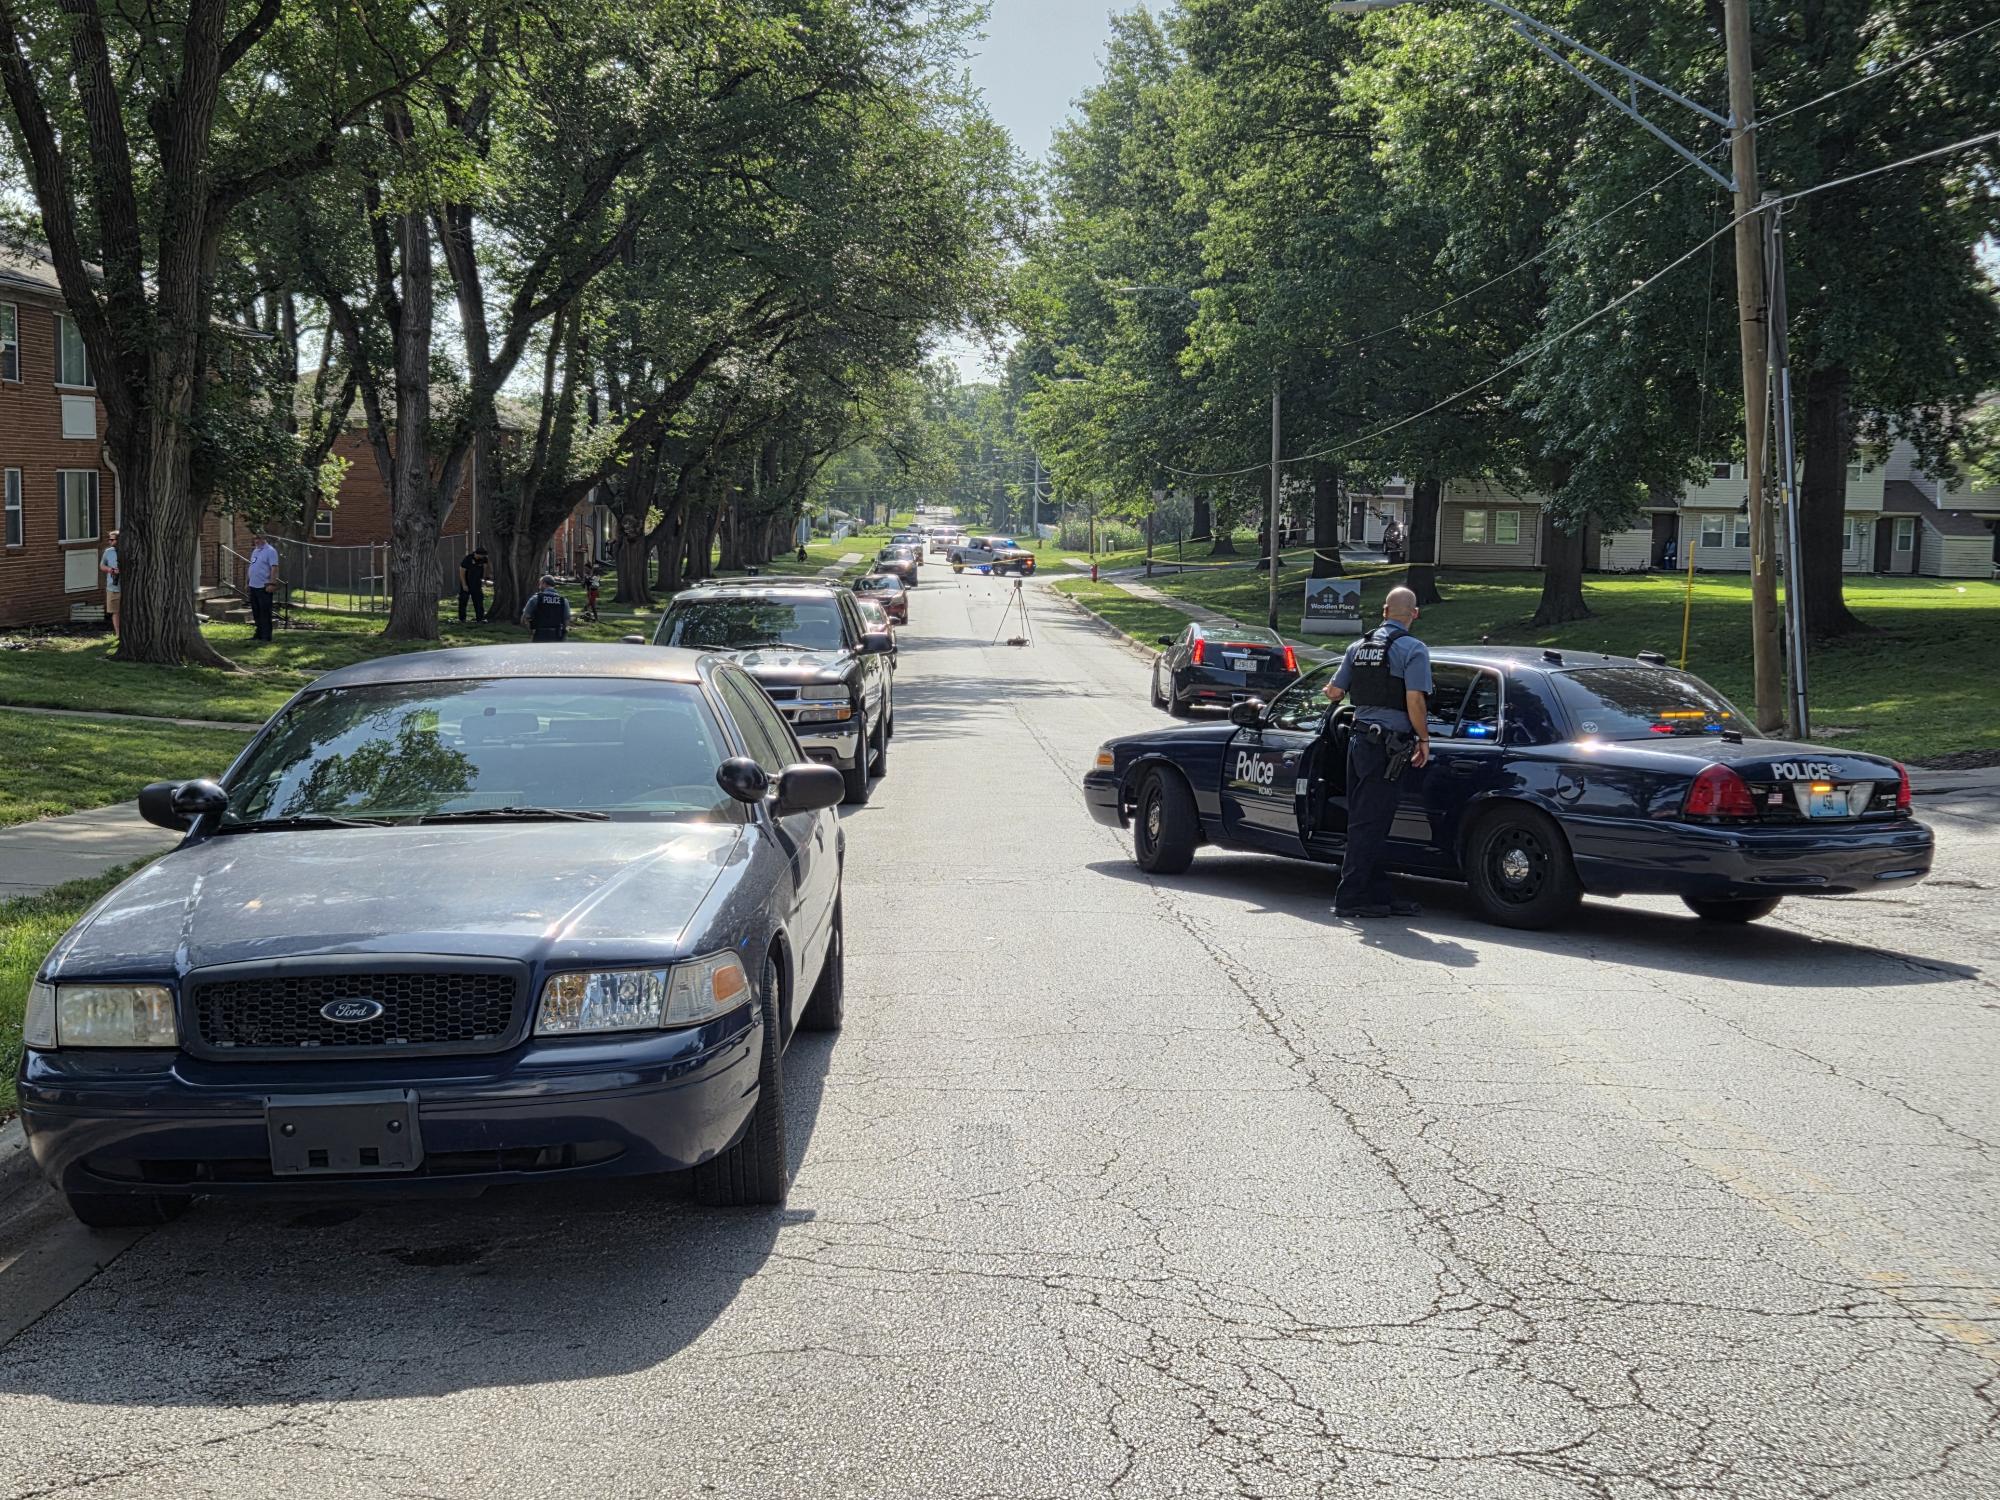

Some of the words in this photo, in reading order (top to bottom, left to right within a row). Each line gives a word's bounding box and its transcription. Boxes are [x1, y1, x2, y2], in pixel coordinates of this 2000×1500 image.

[543, 596, 560, 604] POLICE
[1354, 648, 1385, 661] POLICE
[1236, 751, 1274, 785] Police
[1770, 762, 1831, 780] POLICE
[335, 1003, 368, 1017] Ford
